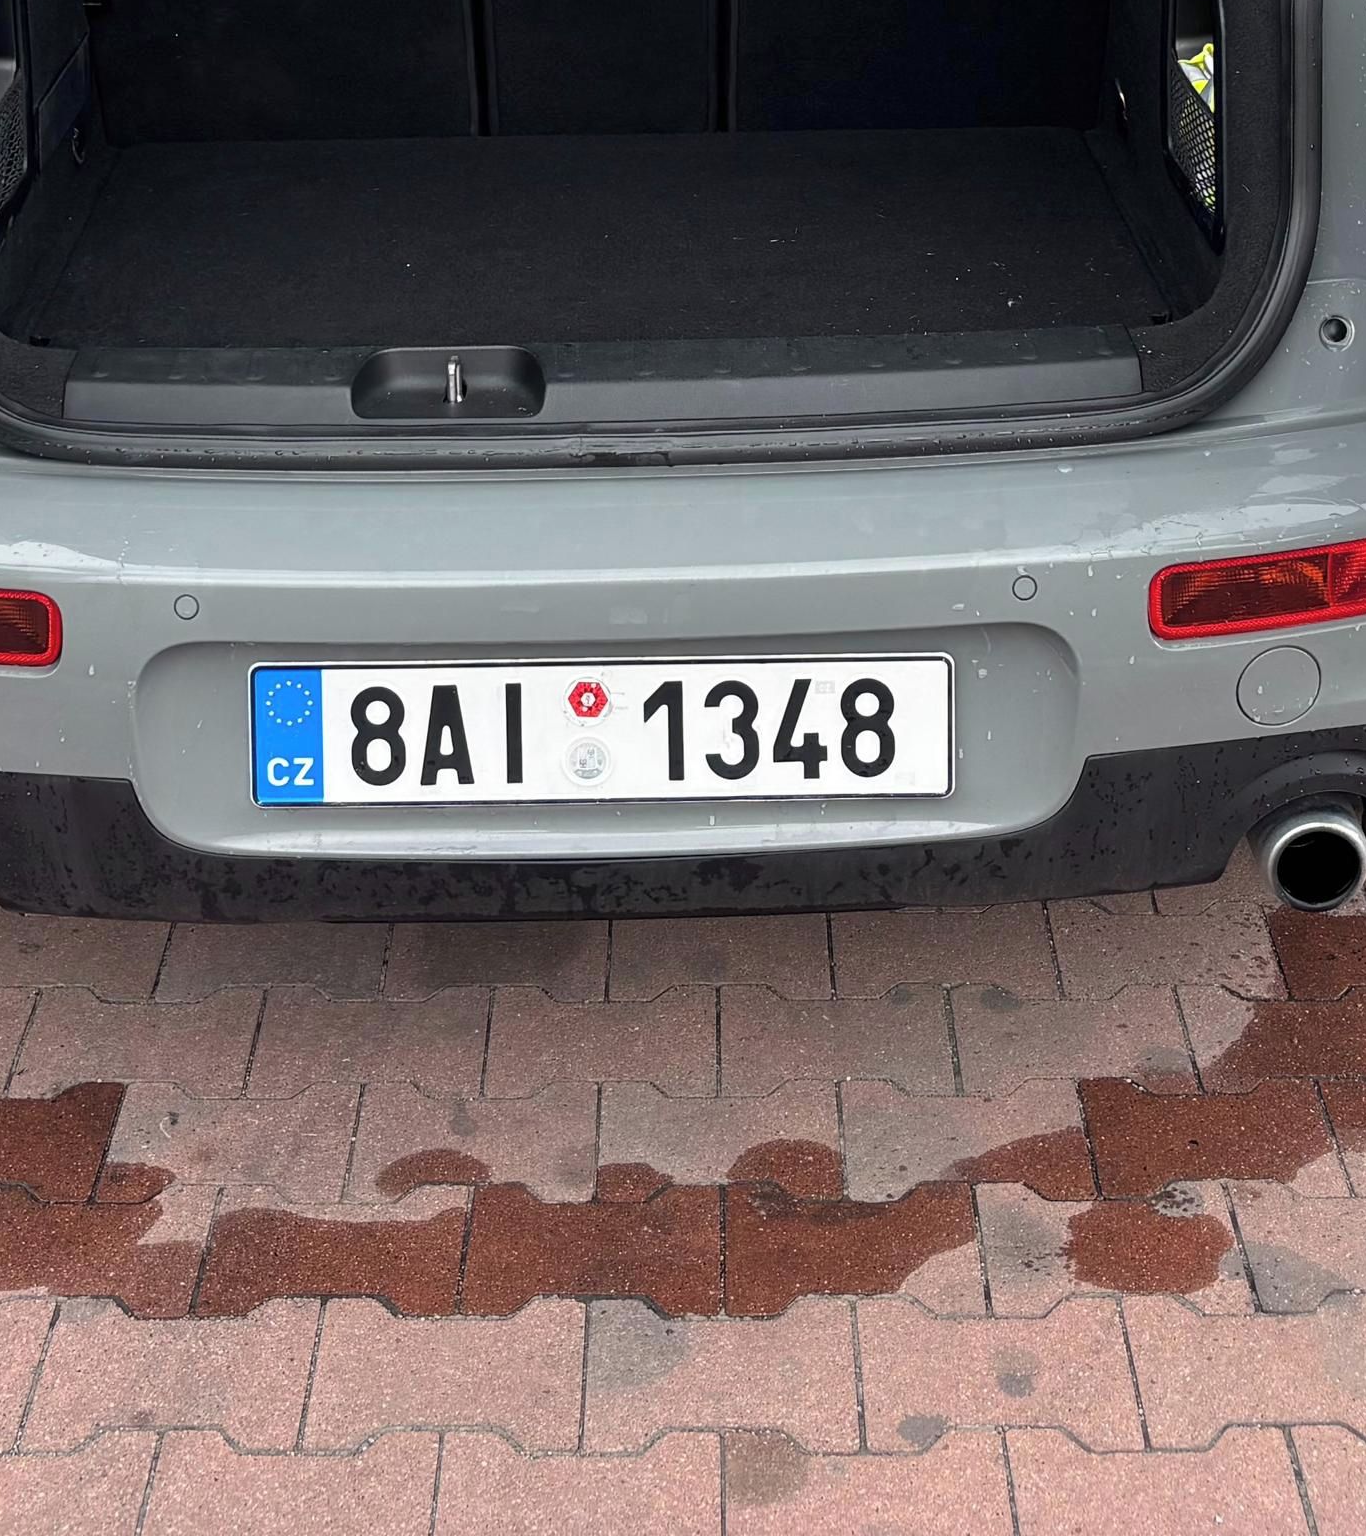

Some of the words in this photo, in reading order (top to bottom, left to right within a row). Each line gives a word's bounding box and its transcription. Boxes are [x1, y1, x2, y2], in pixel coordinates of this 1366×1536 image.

[350, 683, 523, 786] 8AI
[644, 677, 896, 781] 1348
[266, 756, 315, 787] CZ
